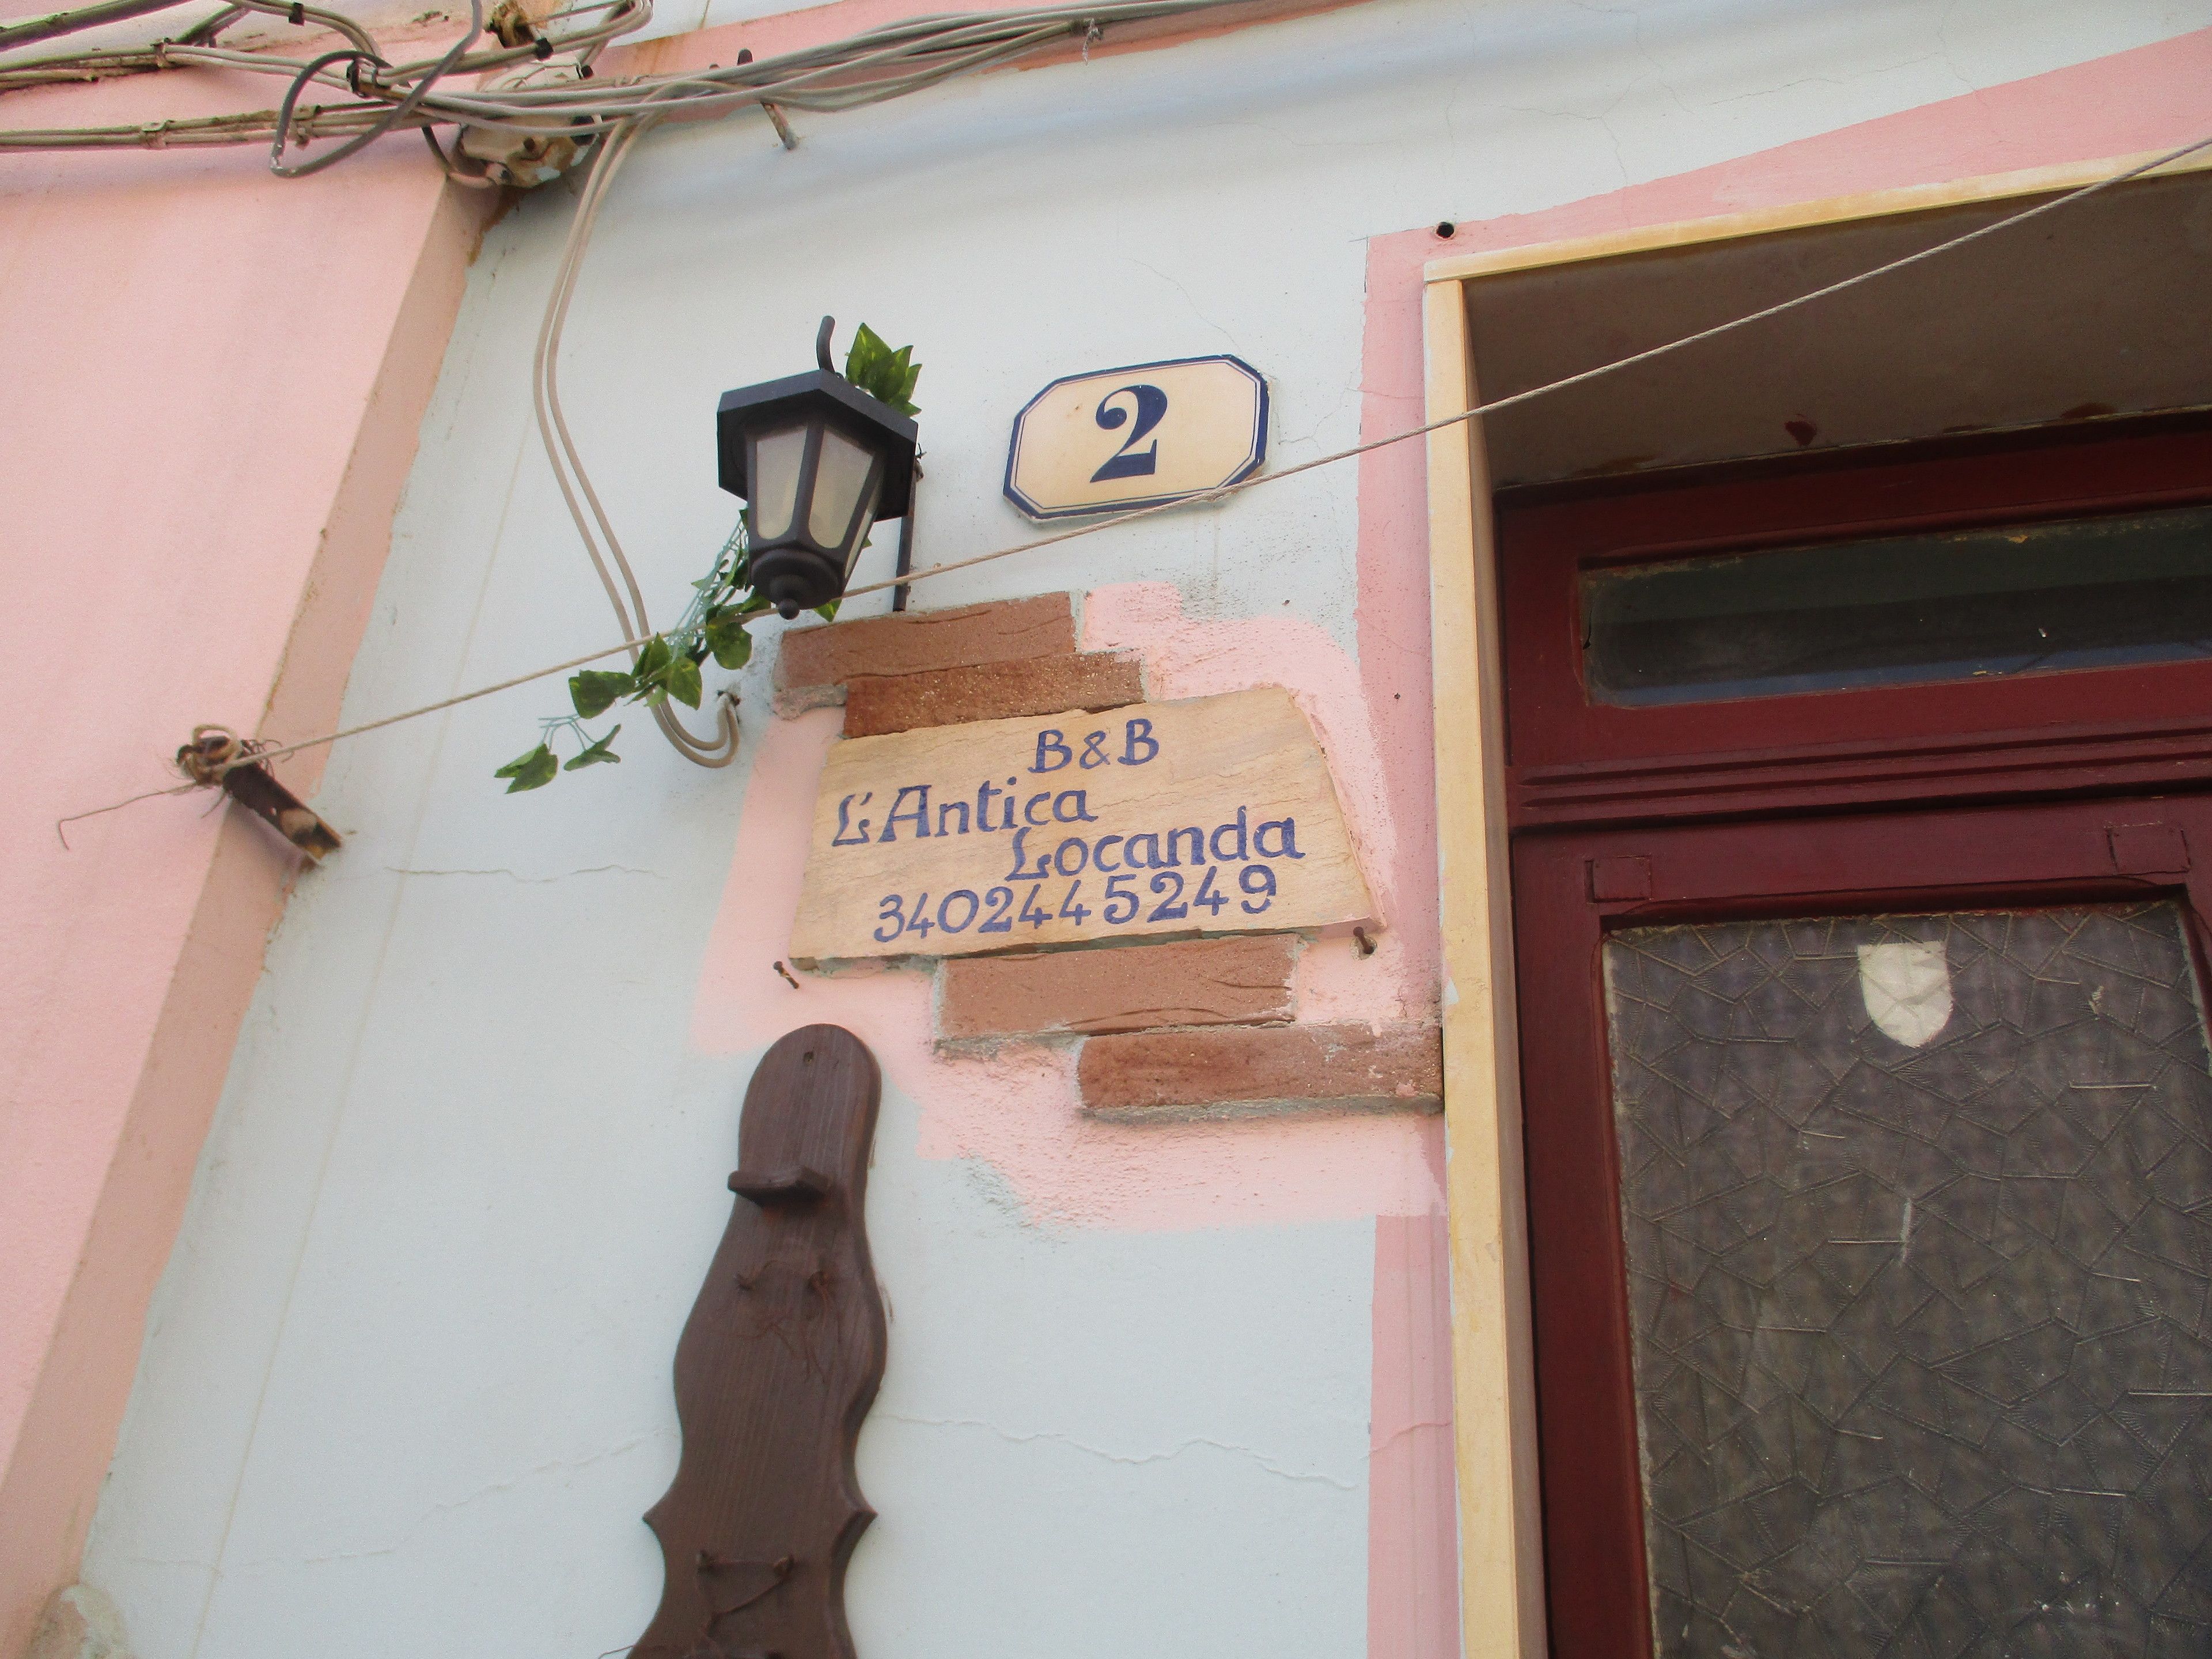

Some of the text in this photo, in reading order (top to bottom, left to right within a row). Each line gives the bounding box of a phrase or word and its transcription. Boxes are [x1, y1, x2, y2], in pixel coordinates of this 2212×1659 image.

[1090, 384, 1168, 483] 2
[831, 776, 1098, 847] L'Antica
[1005, 805, 1306, 881] Locanda
[873, 863, 1278, 943] 3402445249
